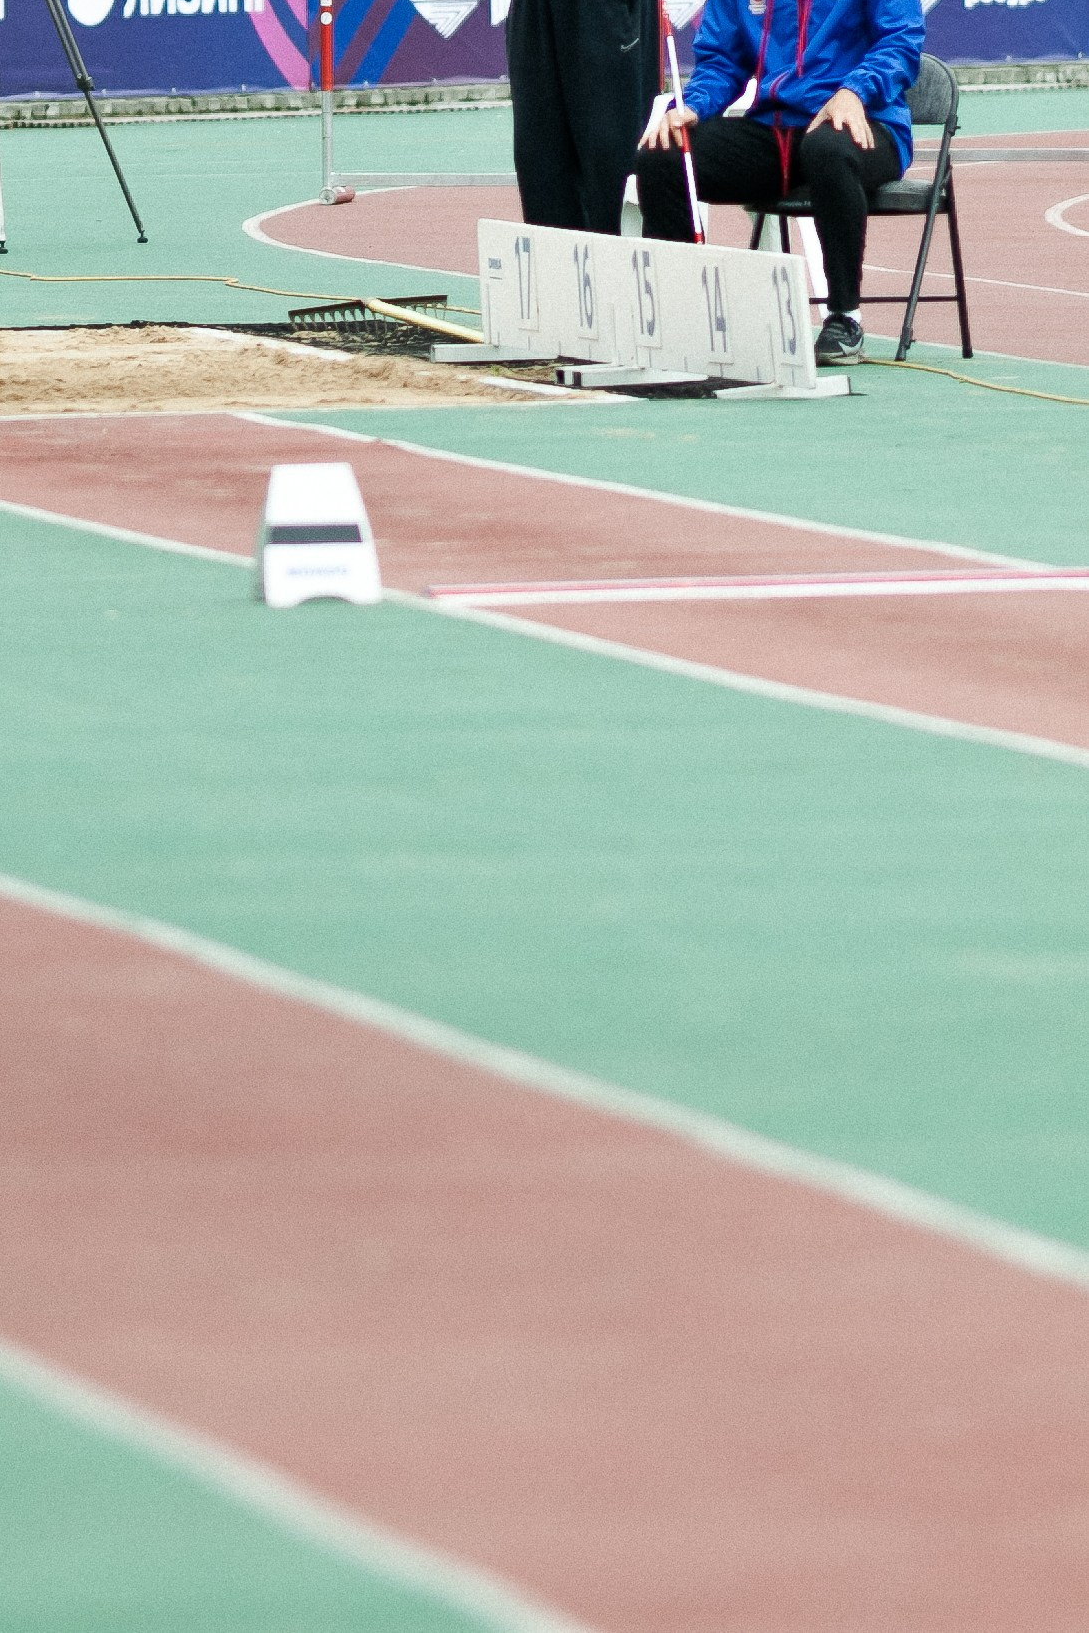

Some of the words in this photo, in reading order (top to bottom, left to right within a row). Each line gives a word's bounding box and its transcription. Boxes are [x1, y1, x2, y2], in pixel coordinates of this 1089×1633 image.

[513, 235, 531, 320] 17
[573, 243, 594, 330] 16
[631, 249, 656, 338] 15
[701, 265, 727, 353] 14
[771, 266, 797, 355] 13
